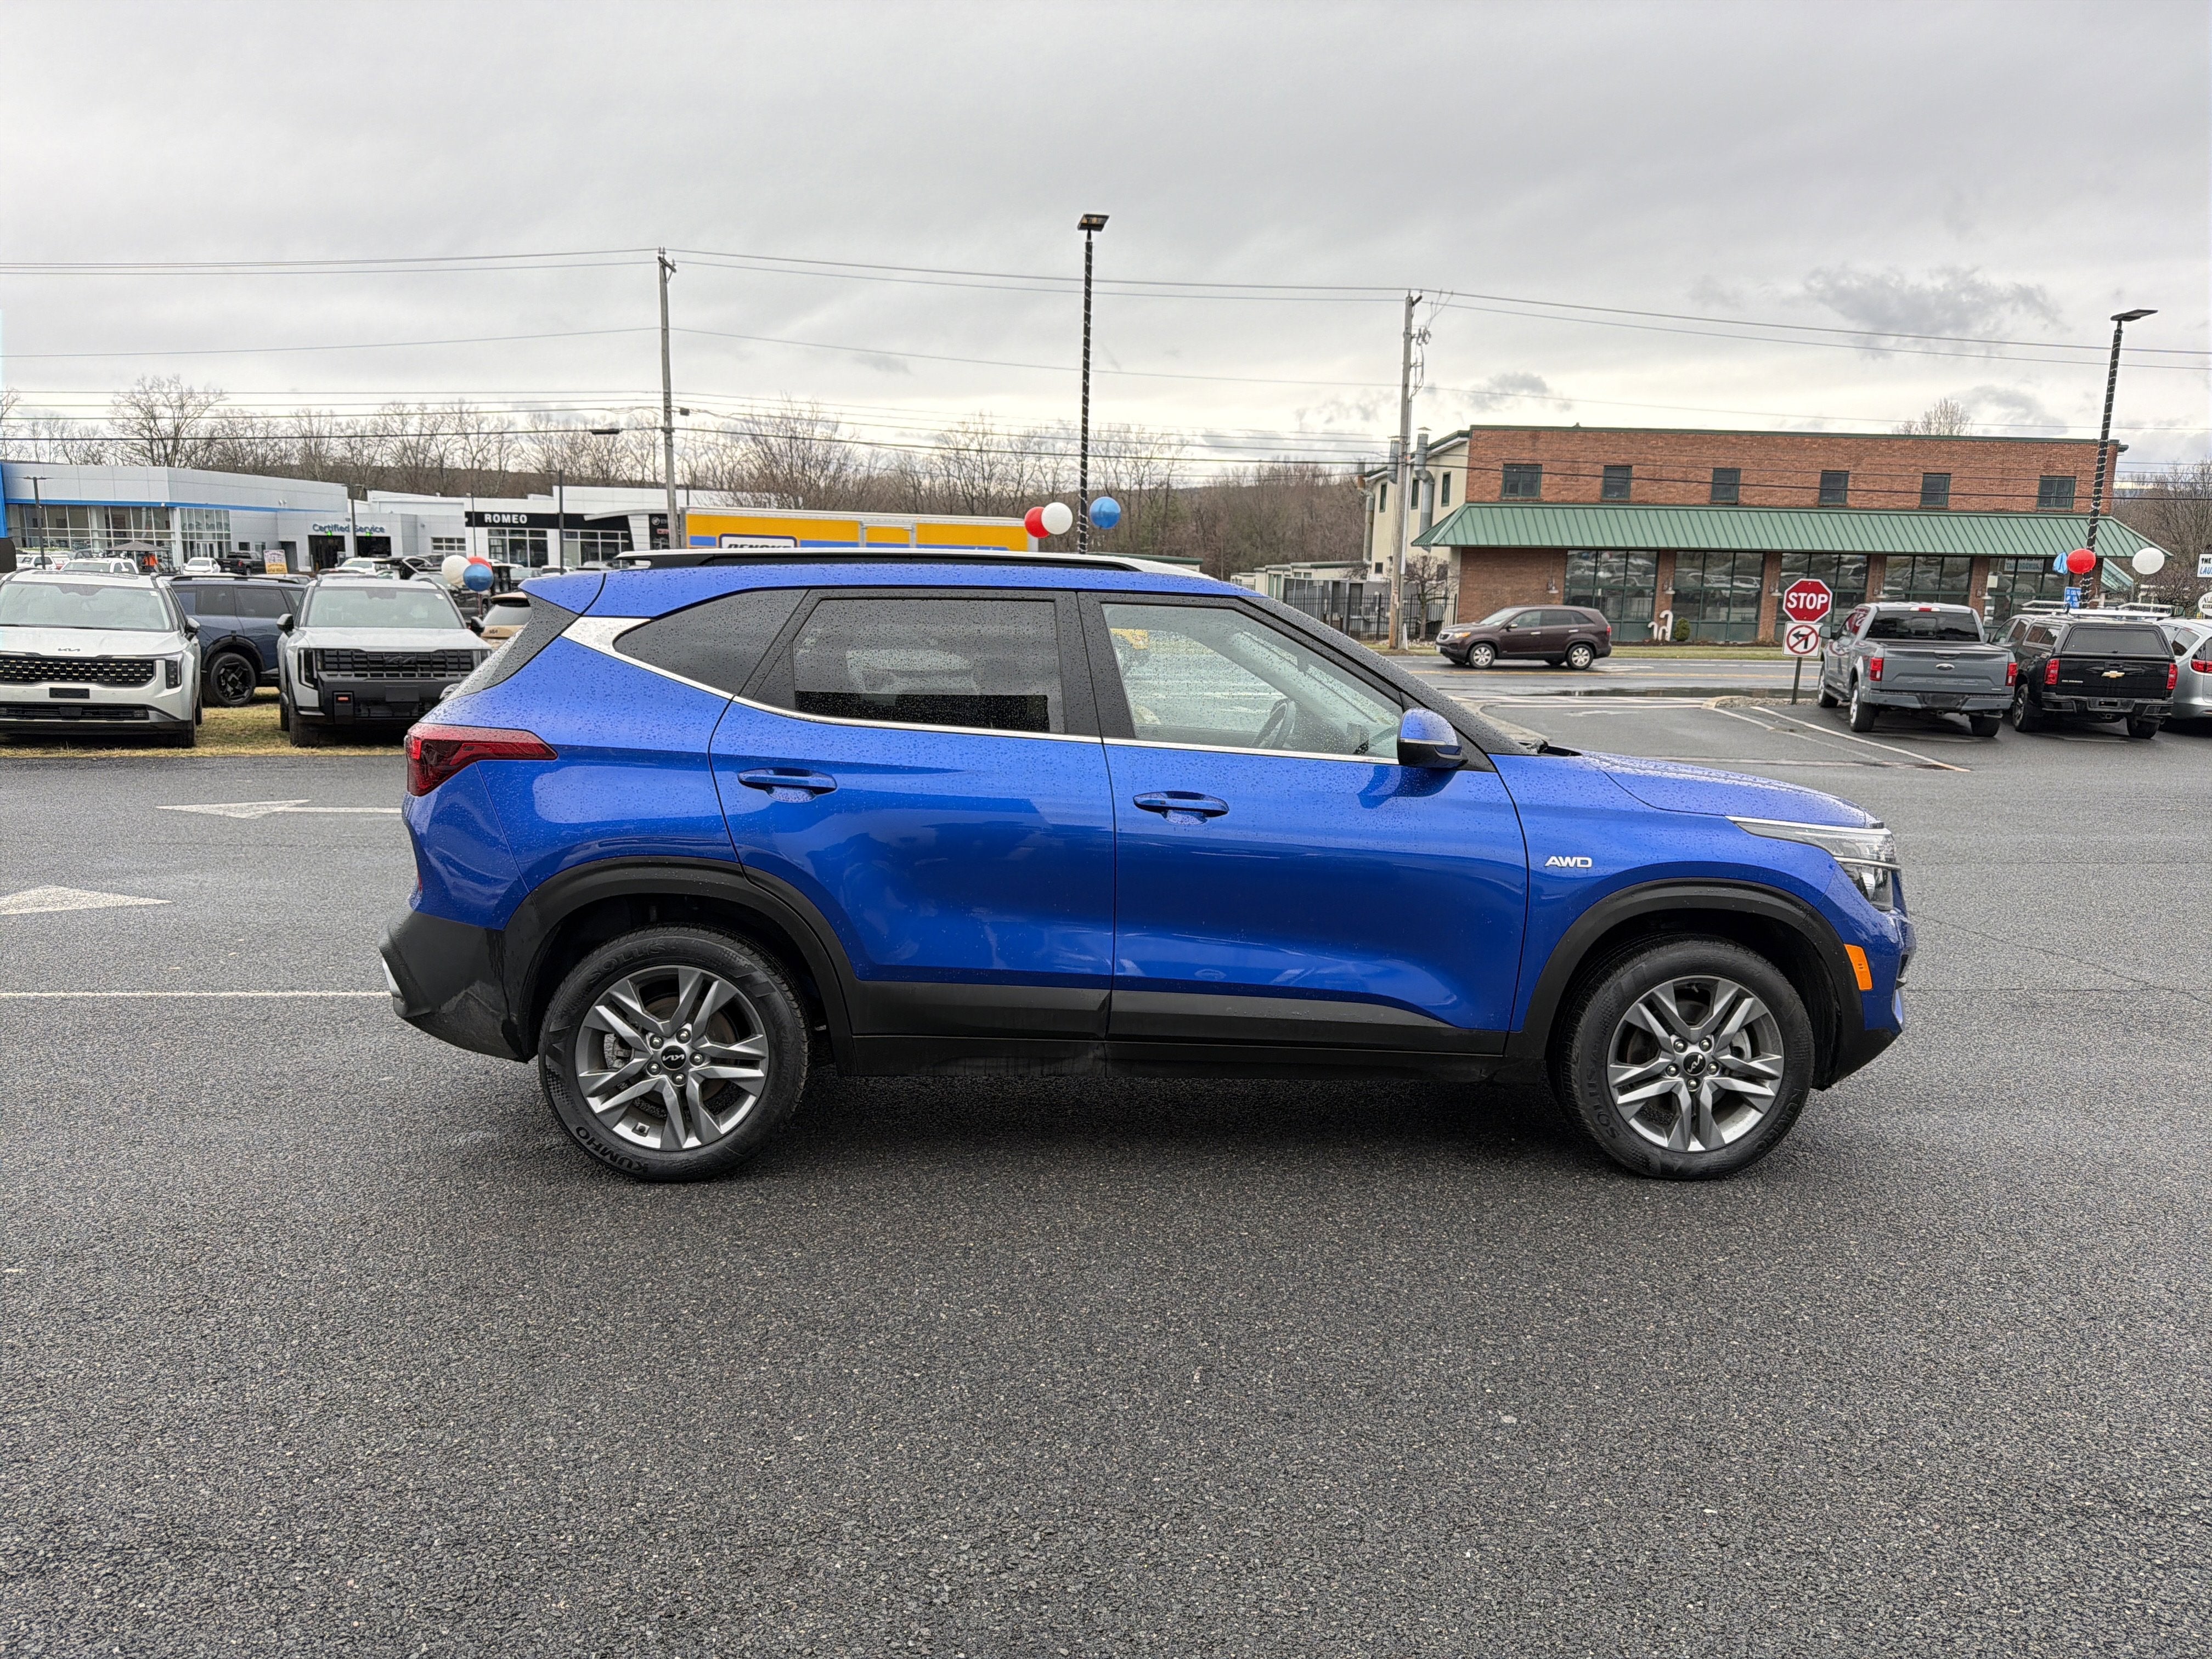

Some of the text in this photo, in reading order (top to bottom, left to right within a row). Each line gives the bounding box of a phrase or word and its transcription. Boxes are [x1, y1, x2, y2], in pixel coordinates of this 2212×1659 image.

[484, 514, 528, 524] ROMEO
[312, 523, 386, 533] Certified Service
[1787, 592, 1829, 610] STOP
[1544, 856, 1592, 868] AWD
[575, 1126, 649, 1172] KUMHO
